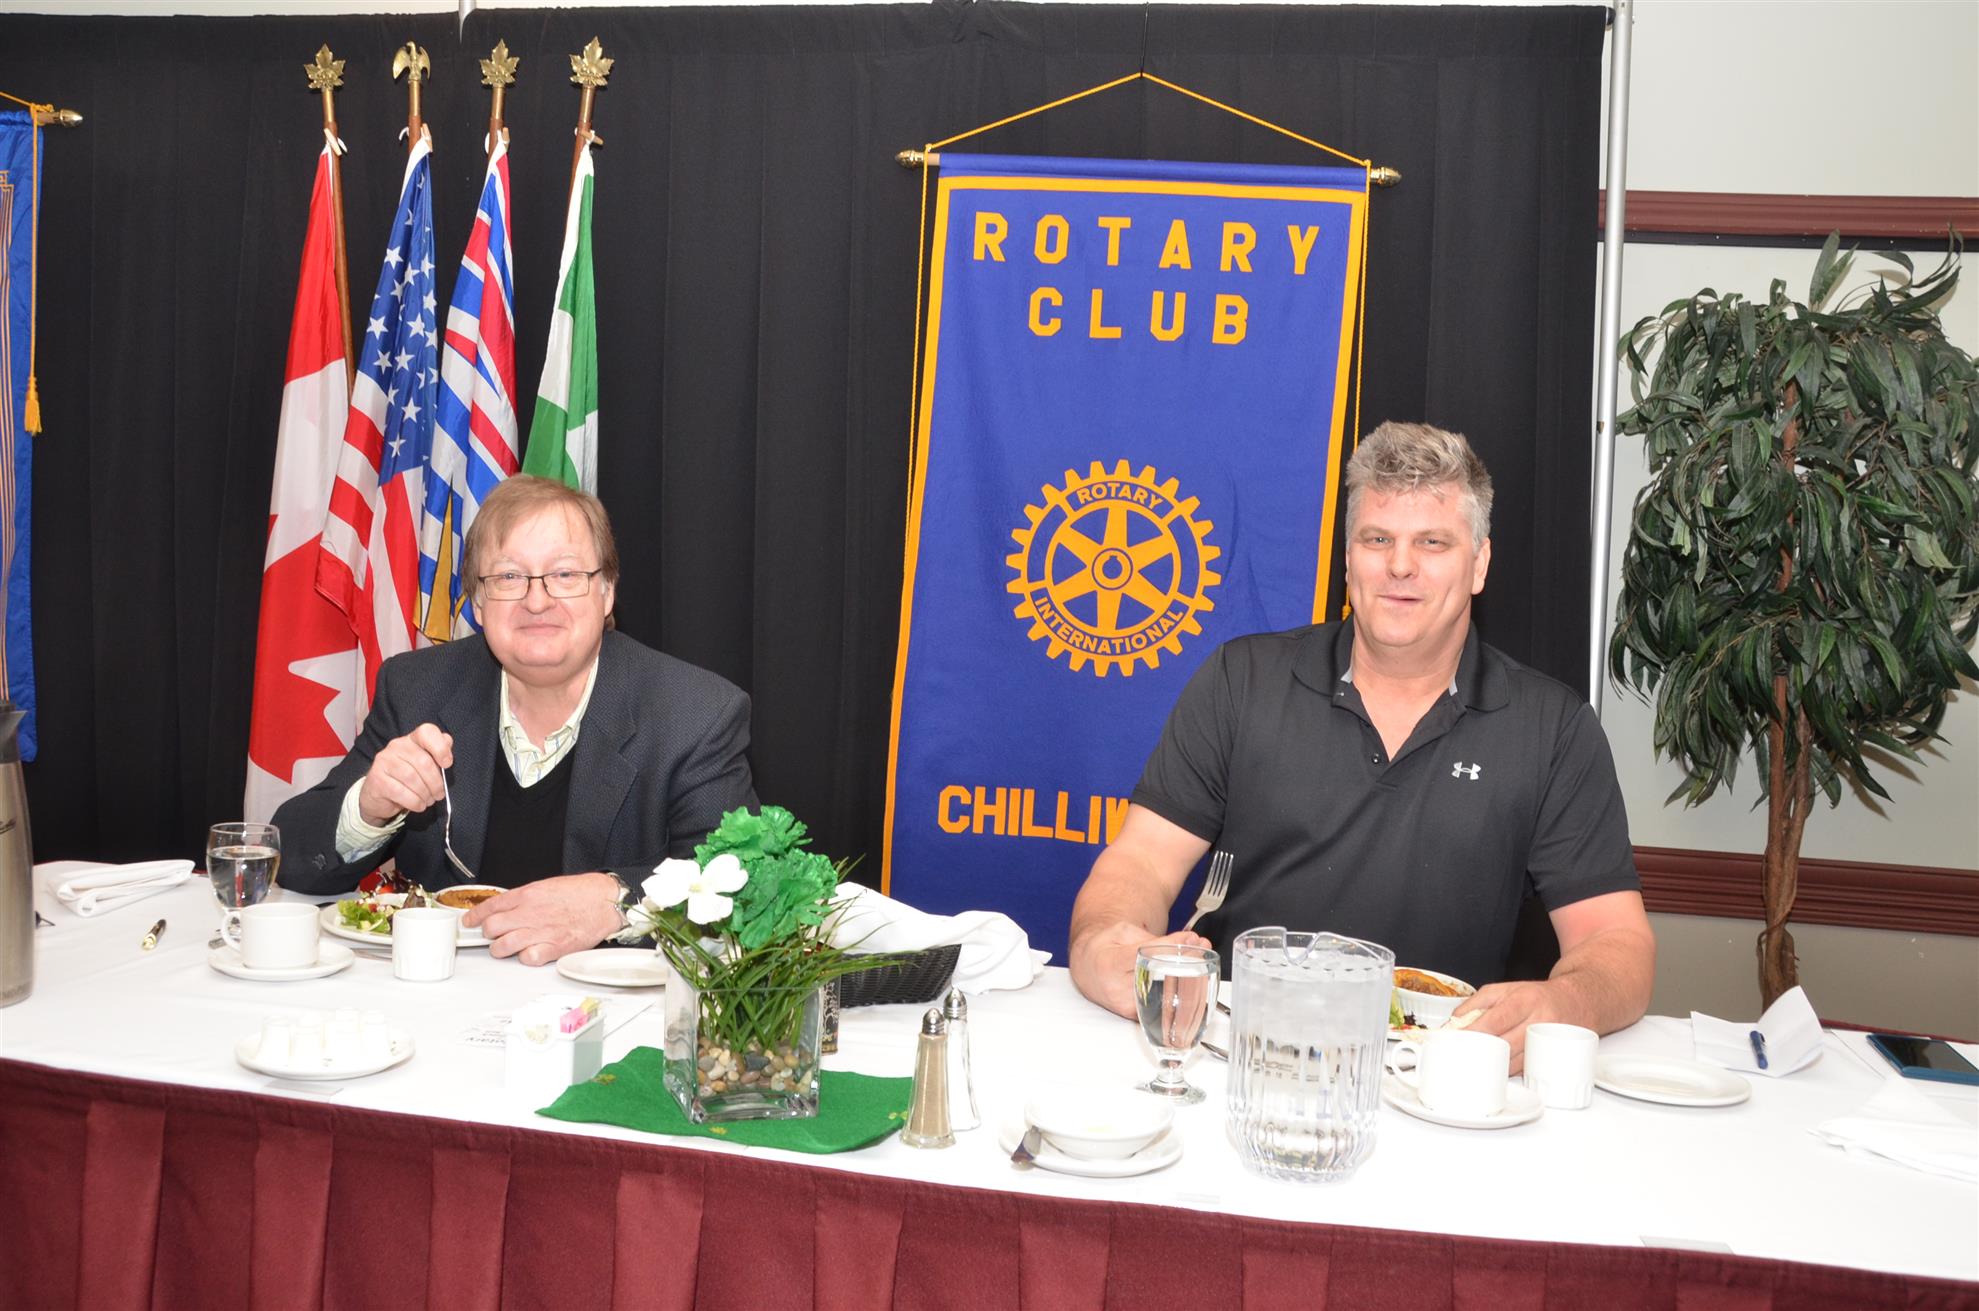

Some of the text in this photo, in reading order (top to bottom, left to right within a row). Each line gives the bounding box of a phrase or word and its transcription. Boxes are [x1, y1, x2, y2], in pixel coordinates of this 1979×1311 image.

[973, 211, 1320, 275] ROTARY
[1028, 286, 1249, 345] CLUB
[1076, 481, 1163, 511] ROTARY
[1034, 595, 1184, 655] INTERNATIONAL
